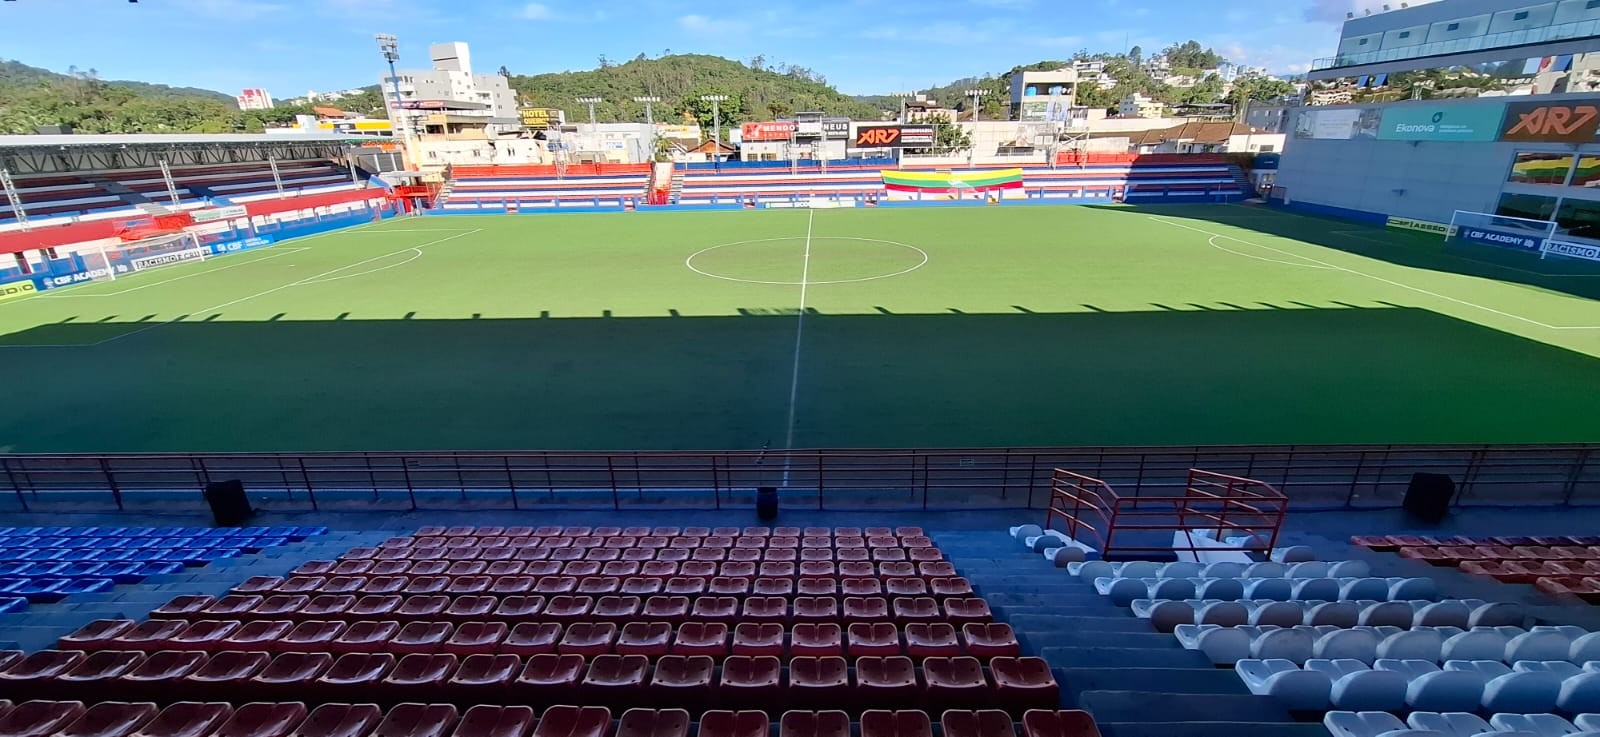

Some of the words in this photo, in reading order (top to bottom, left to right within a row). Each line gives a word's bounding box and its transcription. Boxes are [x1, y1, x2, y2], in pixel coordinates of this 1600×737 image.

[522, 110, 548, 118] HOTEL
[1506, 105, 1598, 135] AR7
[822, 123, 848, 131] NEUS
[1395, 123, 1435, 132] Ekonova
[856, 128, 899, 144] AR7
[1470, 230, 1484, 238] CBF
[1485, 232, 1522, 245] ACADEMY
[54, 274, 73, 285] CBF
